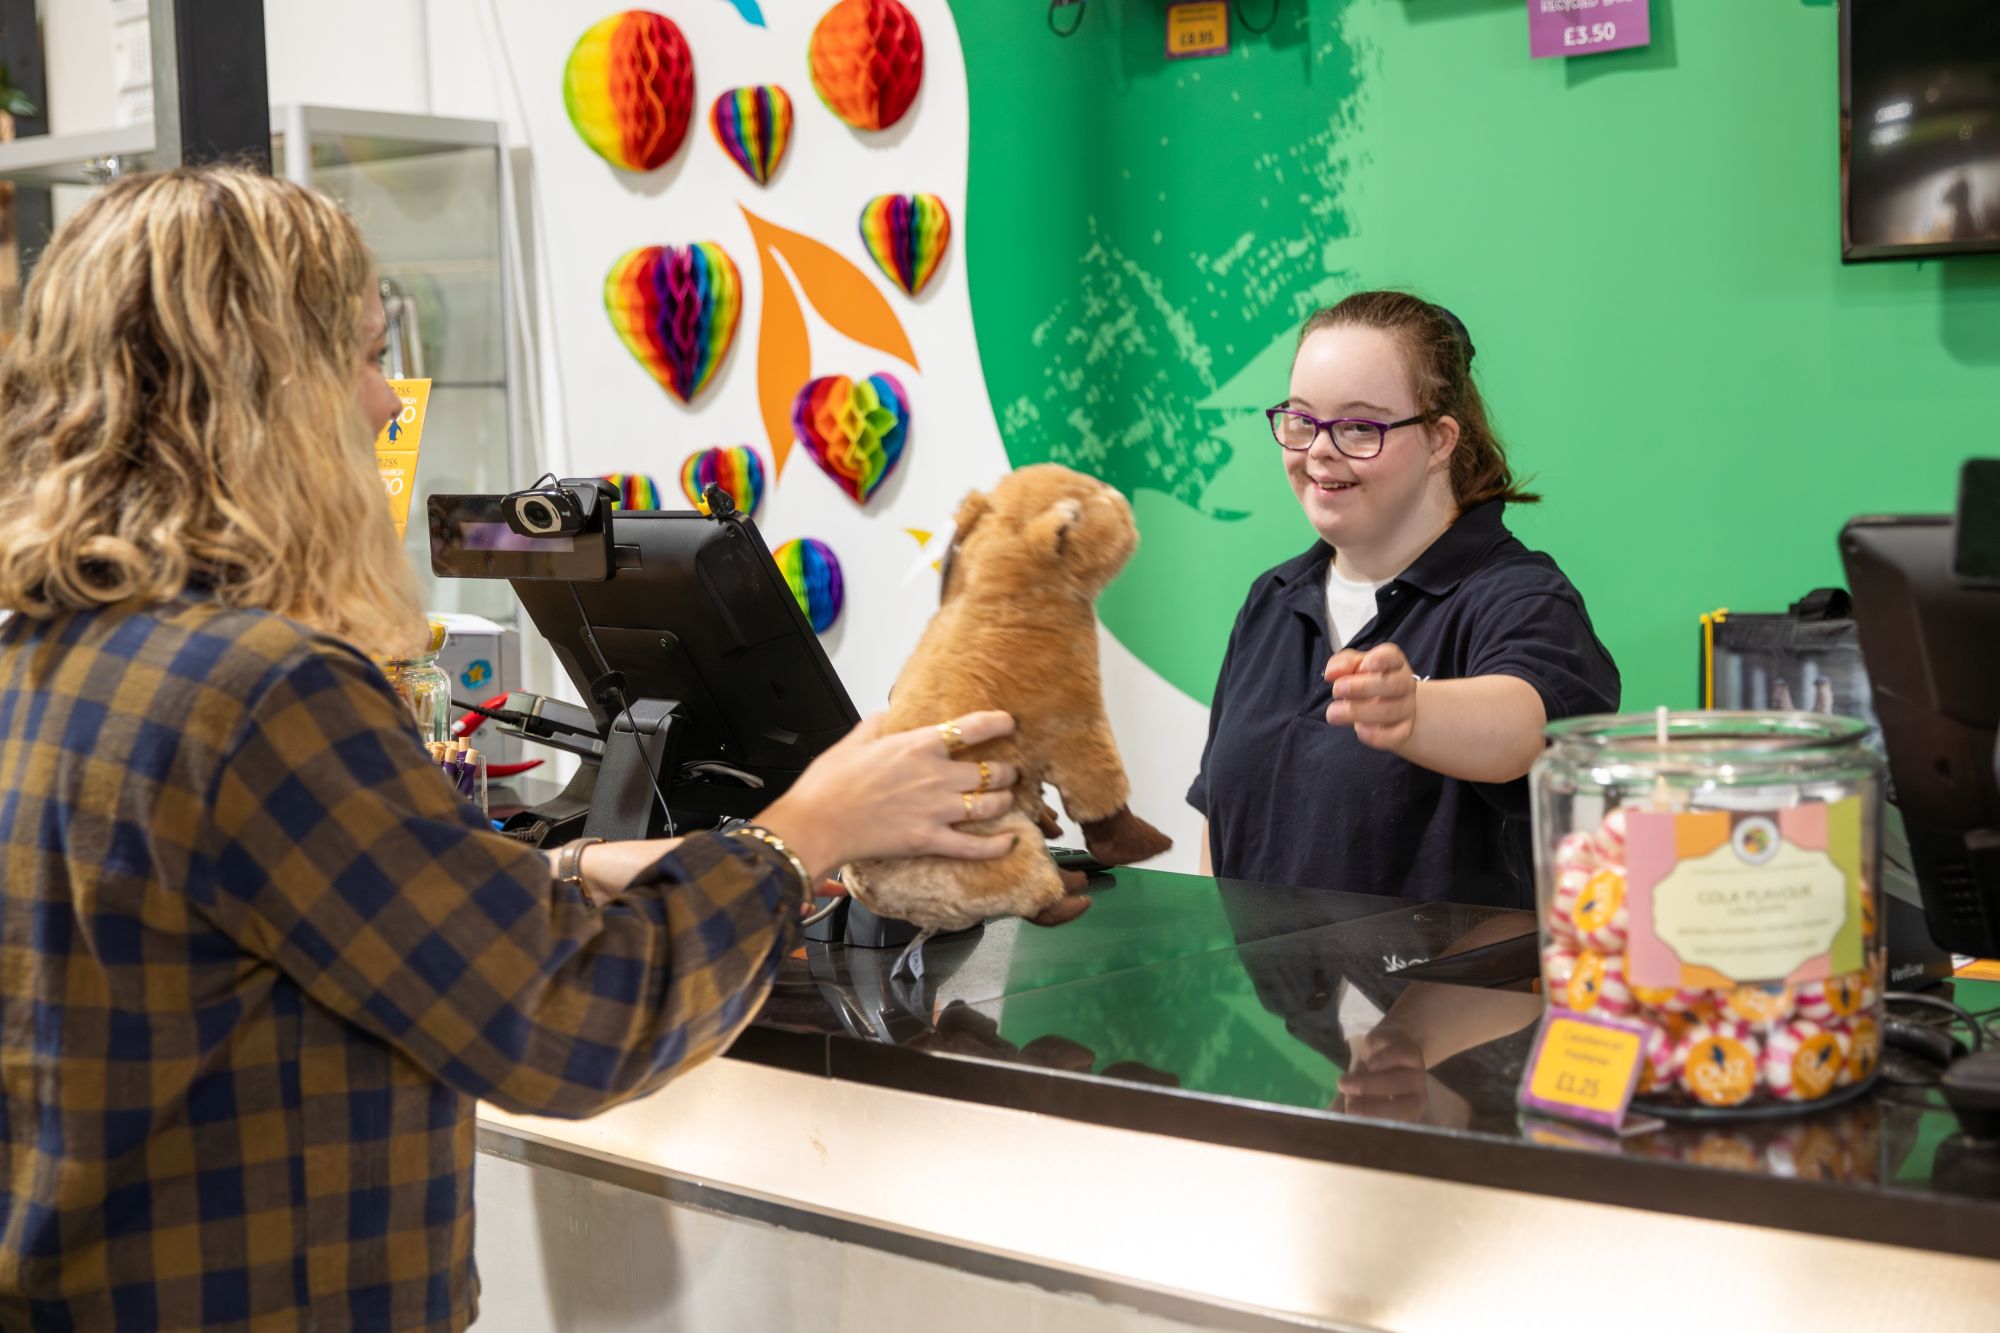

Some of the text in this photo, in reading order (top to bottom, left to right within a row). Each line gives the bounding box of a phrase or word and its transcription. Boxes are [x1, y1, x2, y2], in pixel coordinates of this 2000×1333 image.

[1564, 21, 1616, 46] £3.50
[1697, 890, 1740, 906] COLA
[1556, 1071, 1600, 1099] £1.25
